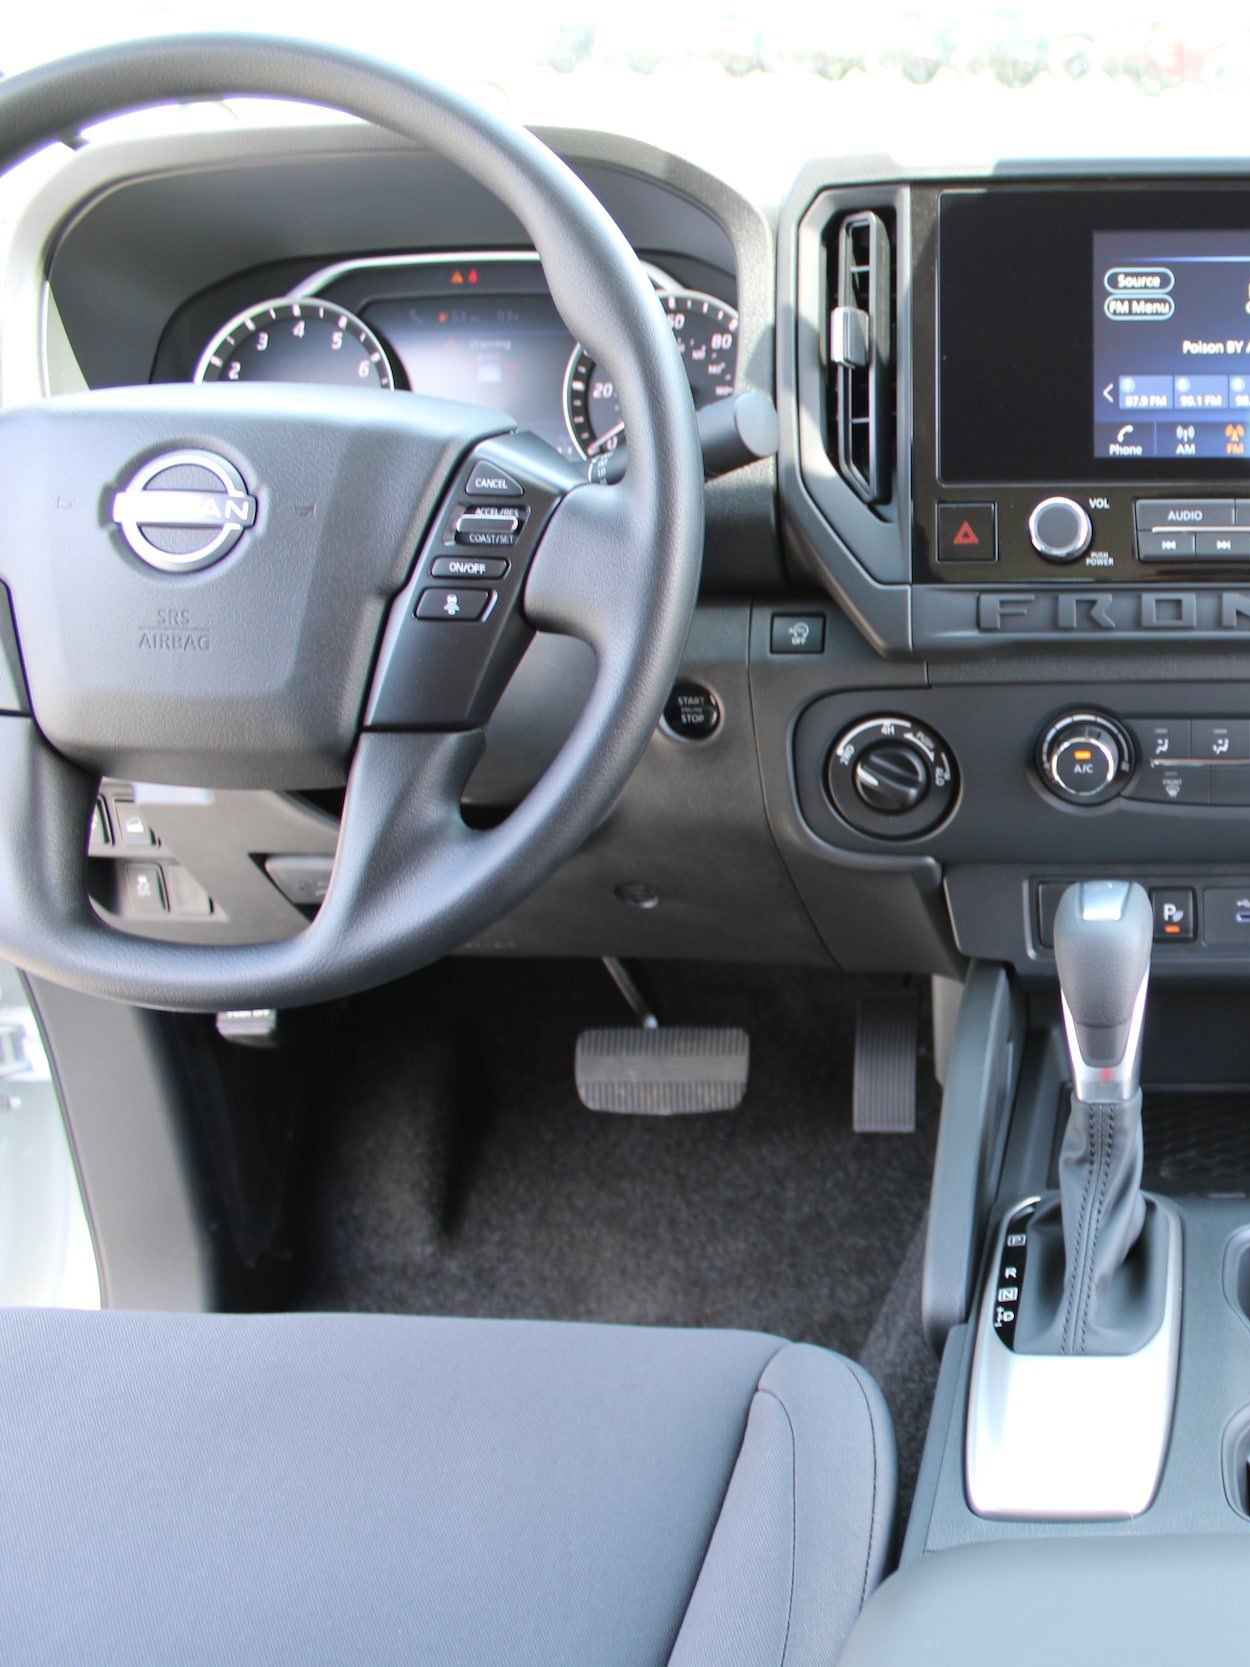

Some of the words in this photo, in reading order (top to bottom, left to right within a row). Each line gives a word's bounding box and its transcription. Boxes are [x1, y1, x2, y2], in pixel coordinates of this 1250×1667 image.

[1117, 274, 1160, 288] Source
[1108, 300, 1129, 314] FM
[1132, 300, 1170, 314] Menu
[292, 320, 305, 338] 4
[256, 332, 269, 351] 3
[331, 331, 343, 350] 5
[711, 333, 733, 350] 80
[1182, 339, 1224, 354] Poison
[1226, 339, 1244, 354] BY
[228, 361, 241, 380] 2
[358, 359, 370, 378] 6
[592, 382, 614, 399] 20
[1149, 395, 1167, 407] FM
[1205, 395, 1222, 407] FM
[1109, 443, 1143, 456] Phone
[1176, 443, 1195, 455] AM
[1226, 443, 1245, 455] FM
[475, 477, 508, 490] CANCEL
[1089, 497, 1110, 509] VOL
[1167, 510, 1203, 521] AUDIO
[469, 533, 514, 545] COAST/SET
[449, 562, 487, 576] ON/OFF
[1086, 558, 1114, 567] POWER
[156, 608, 191, 625] SRS
[137, 632, 212, 651] AIRBAG
[678, 695, 705, 706] START
[681, 713, 705, 725] STOP
[881, 724, 895, 736] 4H
[1073, 763, 1094, 774] A/C
[1162, 778, 1183, 786] FRONT
[1163, 903, 1177, 922] P
[1004, 1267, 1017, 1279] R
[1003, 1310, 1015, 1322] D
